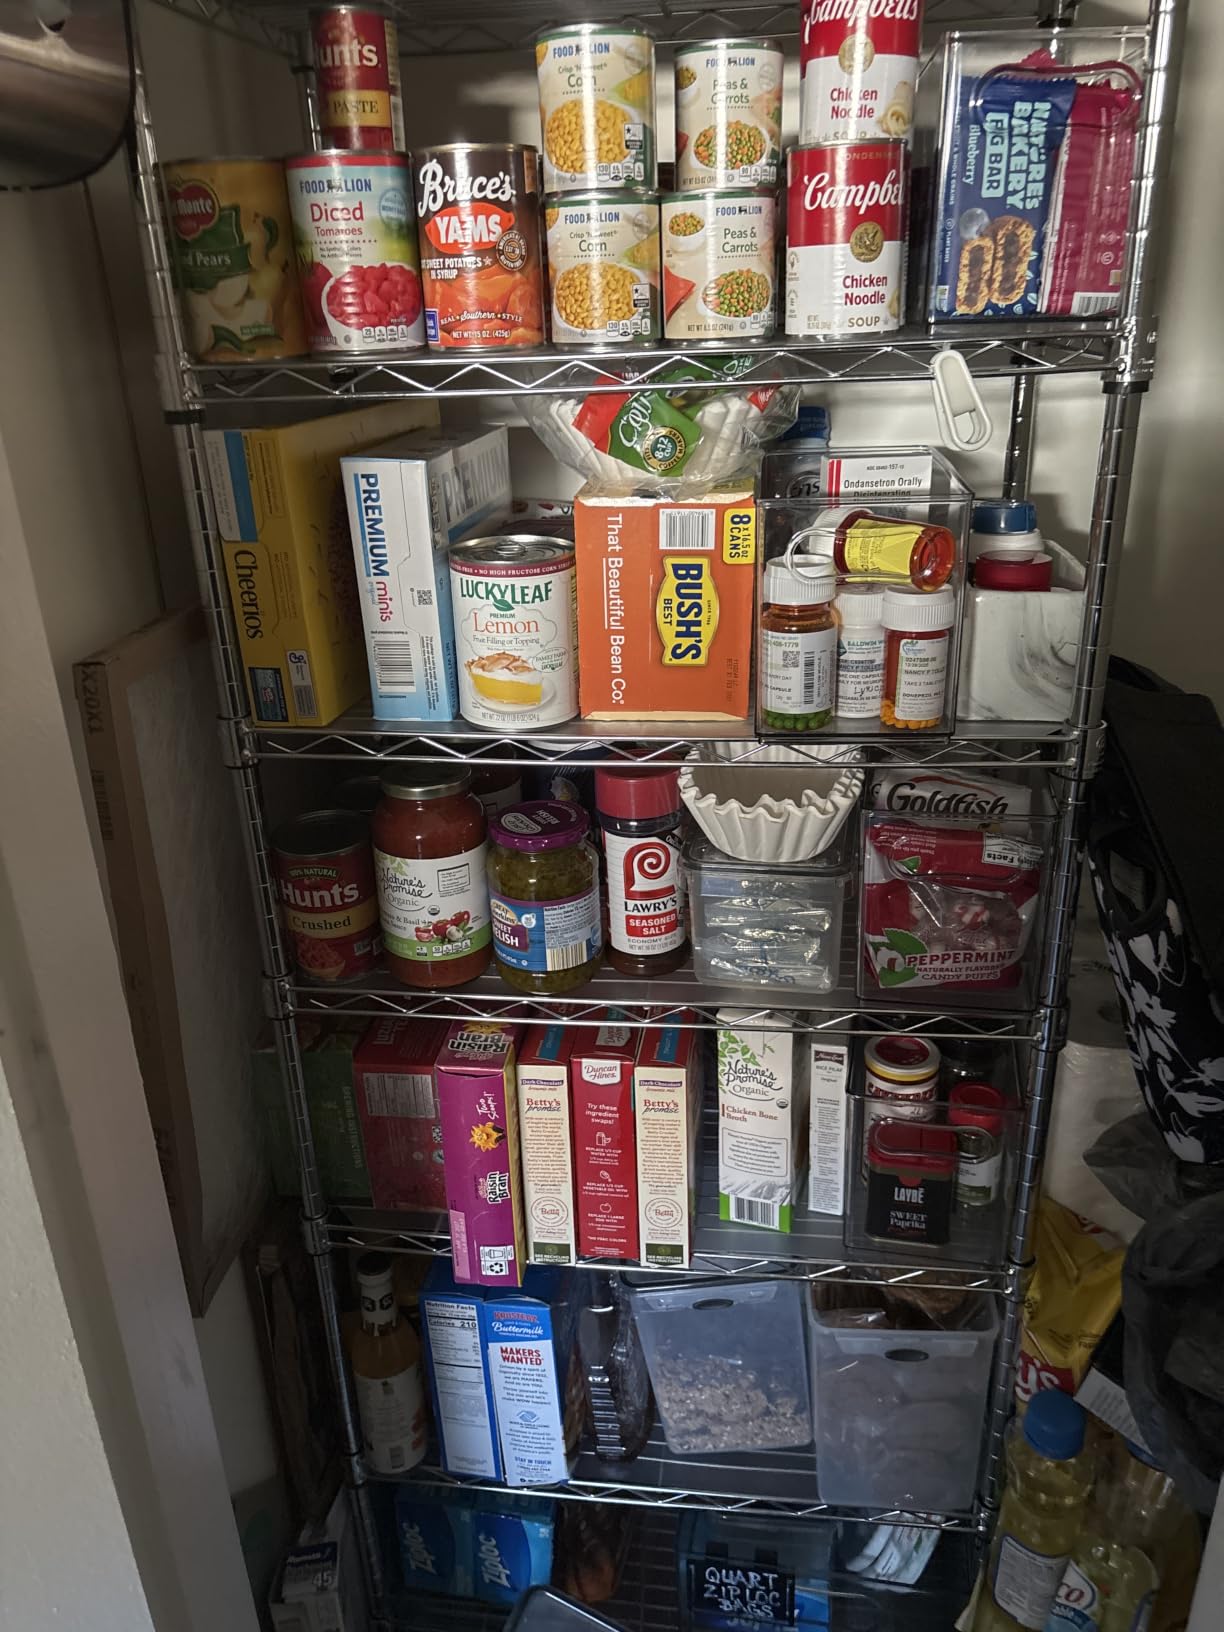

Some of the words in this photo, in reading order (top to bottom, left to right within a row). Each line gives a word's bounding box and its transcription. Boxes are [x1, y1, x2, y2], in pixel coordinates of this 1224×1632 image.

[553, 45, 574, 59] FOOD
[567, 73, 597, 88] Con
[713, 80, 738, 90] Pas
[740, 78, 748, 90] &
[711, 93, 750, 105] Crrots
[830, 87, 878, 102] Chicen
[333, 100, 379, 114] PASTE
[962, 124, 982, 185] Blueberry
[1006, 101, 1033, 210] BAKERY
[986, 153, 1003, 191] BAR
[300, 178, 326, 195] FOOD
[343, 178, 373, 193] LION
[417, 158, 517, 218] Bruce's
[309, 199, 365, 224] Diced
[716, 206, 737, 216] FOOD
[748, 205, 763, 214] LION
[564, 213, 585, 225] FOOD
[599, 212, 620, 223] LION
[314, 226, 364, 238] Tomatoes
[435, 213, 503, 244] YAMS
[723, 227, 748, 240] Peas
[749, 226, 757, 239] &
[578, 239, 607, 253] Corn
[721, 241, 758, 254] Carrots
[195, 252, 233, 267] Pears
[436, 268, 459, 280] SYRUP
[842, 274, 888, 289] Chicken
[844, 290, 886, 306] Noodle
[460, 309, 497, 322] Southern
[848, 316, 880, 328] SOUP
[655, 436, 669, 458] 8-12
[663, 442, 673, 457] CUP
[843, 478, 896, 489] Ondansetron
[897, 477, 923, 488] Orally
[360, 472, 391, 578] PREMIUM
[729, 514, 752, 525] 8
[607, 513, 623, 552] That
[729, 526, 742, 559] CANS
[489, 568, 506, 576] HIGH
[507, 566, 541, 576] FRUCTOSE
[542, 565, 557, 573] CORN
[232, 550, 265, 641] Cheerios
[460, 577, 510, 601] LUCKY
[509, 580, 553, 606] LEAF
[608, 557, 624, 631] Beautiful
[375, 580, 394, 623] minis
[663, 598, 673, 626] BEST
[671, 563, 704, 661] BUSH'S
[472, 611, 540, 634] Lemon
[472, 634, 486, 643] Fruit
[486, 635, 506, 646] Filling
[513, 636, 540, 648] Topping
[610, 635, 625, 674] Bean
[887, 782, 1009, 816] Goldfish
[986, 852, 1015, 865] Facts
[303, 867, 338, 879] NATURAL
[383, 867, 427, 889] Nature's
[386, 893, 419, 906] Organic
[624, 895, 677, 913] LAWRY'S
[293, 916, 351, 931] Crushed
[403, 915, 420, 926] Basil
[629, 913, 676, 927] SEASONED
[642, 925, 666, 936] SALT
[906, 950, 1015, 967] PEPPERMINT
[916, 965, 964, 973] NATURALLY
[921, 972, 962, 981] CANDY
[965, 971, 1000, 981] PUFFS
[458, 1032, 504, 1043] Bran
[449, 1040, 508, 1053] Raisin
[584, 1064, 618, 1075] Duncan
[588, 1071, 618, 1081] Hines
[727, 1059, 778, 1082] Nature's
[723, 1072, 784, 1091] Promise
[732, 1084, 770, 1098] Organic
[475, 1097, 490, 1116] Two
[526, 1097, 561, 1107] Betty's
[586, 1102, 598, 1110] Try
[599, 1103, 618, 1111] these
[643, 1098, 679, 1108] Betty's
[525, 1105, 562, 1114] promise
[585, 1110, 620, 1118] ingredient
[642, 1106, 680, 1115] promise
[726, 1105, 757, 1117] Chicken
[758, 1109, 779, 1121] Bone
[591, 1117, 615, 1125] swaps!
[725, 1112, 748, 1124] Broth
[487, 1171, 500, 1204] Raisin
[498, 1172, 509, 1199] Bran
[889, 1210, 928, 1222] SWEET
[889, 1217, 926, 1230] Paprika
[425, 1301, 455, 1309] Nutrition
[428, 1318, 455, 1327] Calories
[459, 1320, 477, 1328] 210
[491, 1321, 544, 1335] Buttermilk
[500, 1345, 541, 1358] MAKERS
[501, 1354, 543, 1366] WANTED
[402, 1522, 438, 1575] Ziploc
[480, 1532, 510, 1589] Ziploc
[704, 1566, 779, 1590] QUART
[719, 1597, 774, 1619] BAGS
